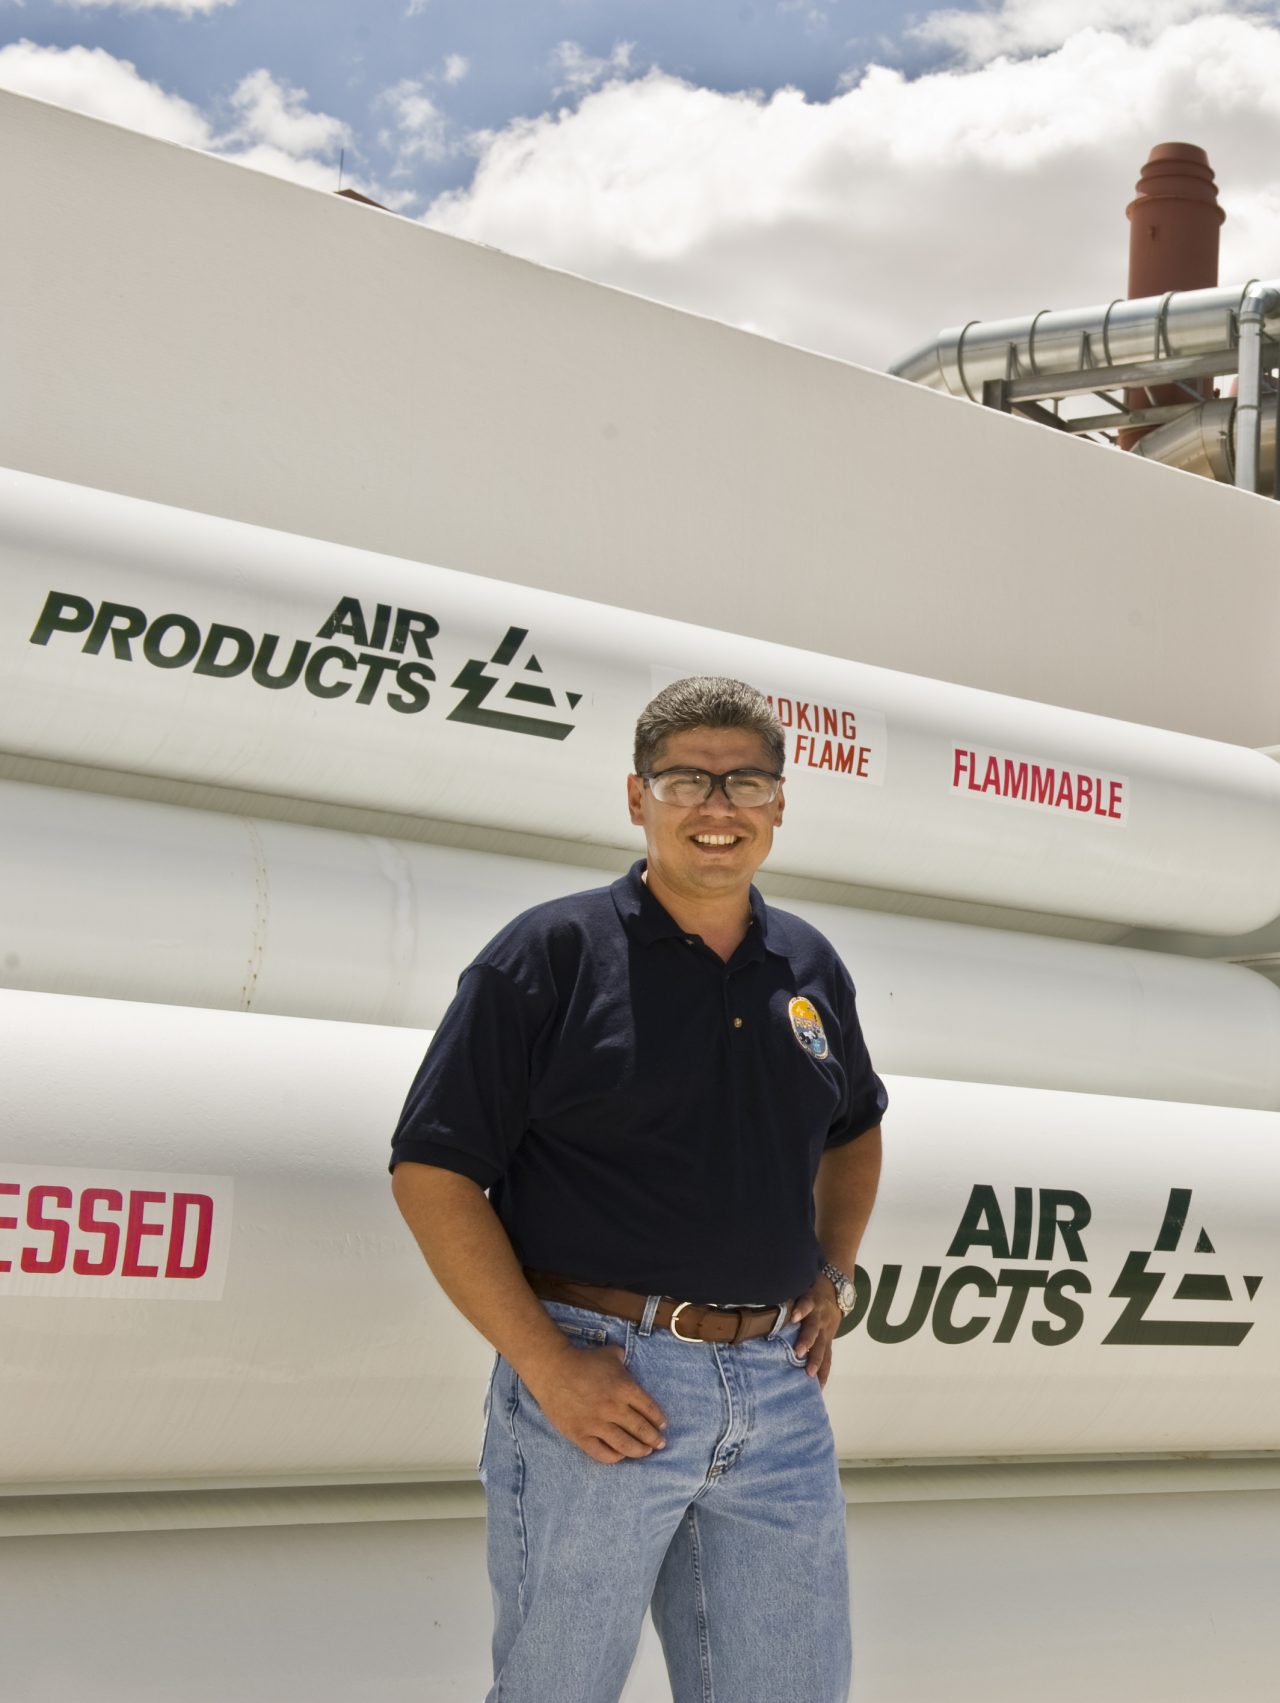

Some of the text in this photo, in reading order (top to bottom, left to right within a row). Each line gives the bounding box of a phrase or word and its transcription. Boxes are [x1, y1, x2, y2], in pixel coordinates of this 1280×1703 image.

[30, 591, 436, 713] PRODUCTS
[316, 597, 439, 660] AIR
[767, 695, 857, 740] OKING
[793, 735, 872, 778] FLAME
[954, 749, 1123, 819] FLAMMABLE
[0, 1183, 213, 1280] SSED
[946, 1184, 1092, 1263] AIR
